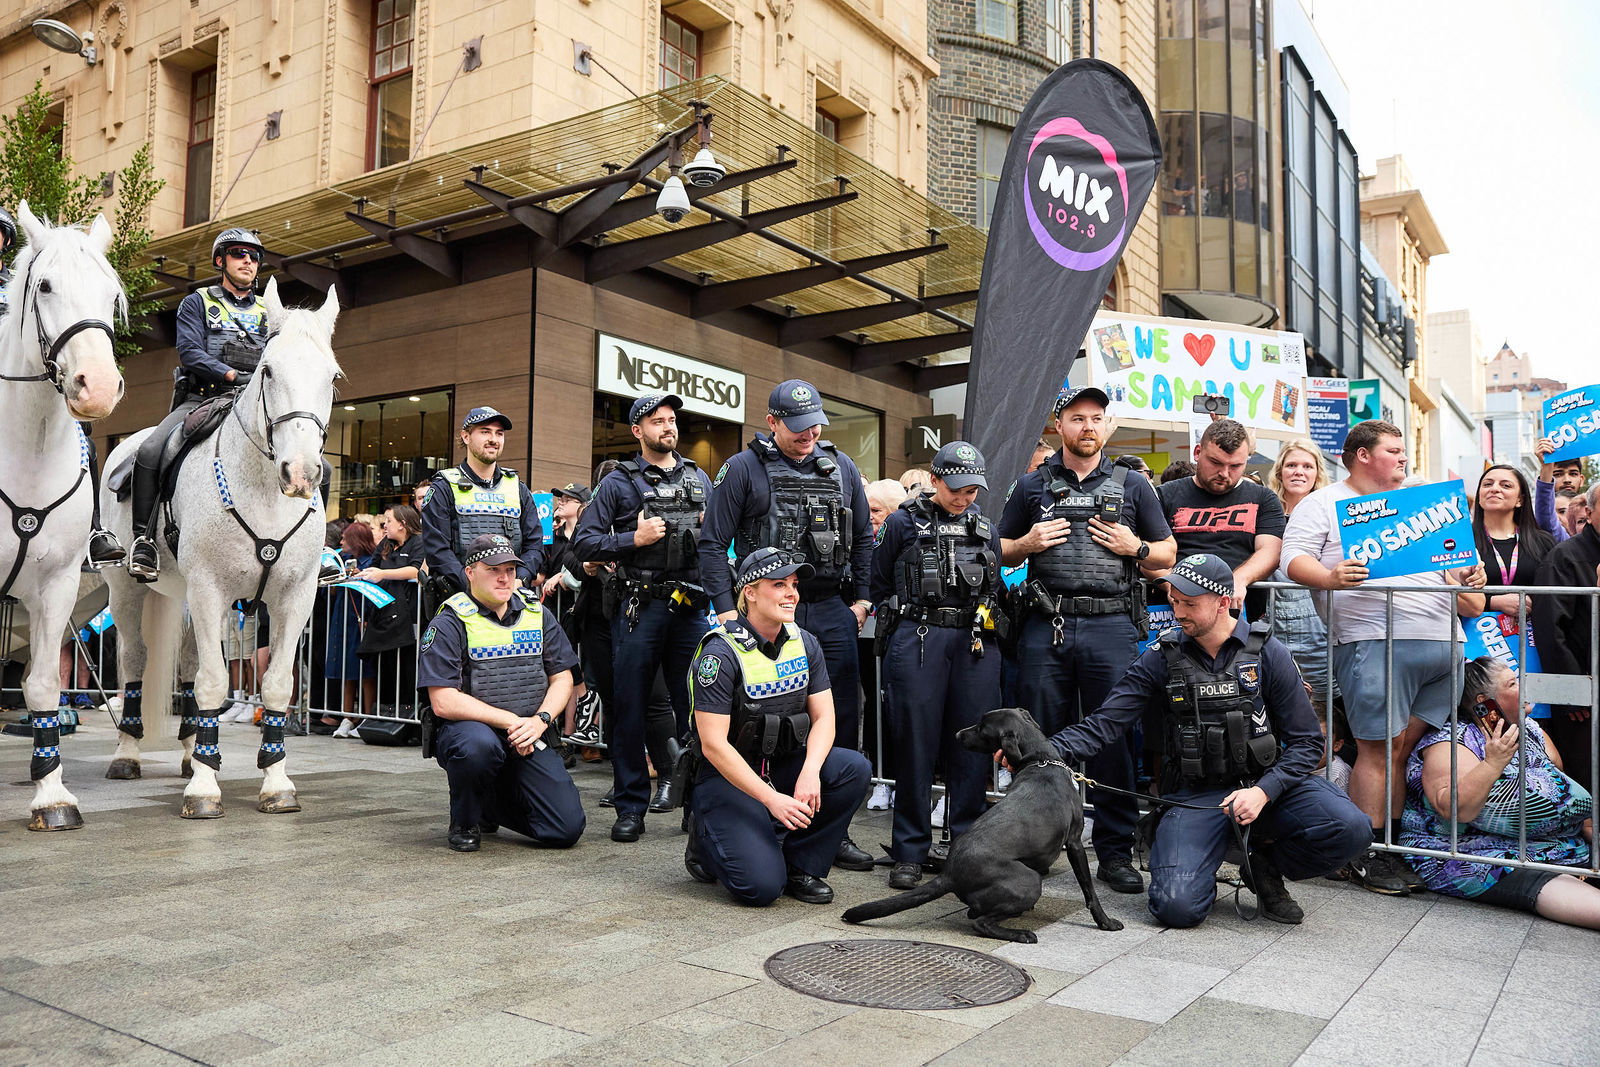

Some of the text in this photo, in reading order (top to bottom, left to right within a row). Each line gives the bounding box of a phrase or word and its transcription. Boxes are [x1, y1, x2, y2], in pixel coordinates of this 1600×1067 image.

[1038, 154, 1113, 224] MIX
[1047, 202, 1096, 239] 102.3
[1134, 325, 1251, 371] WE U
[613, 345, 741, 409] NESPRESSO
[1128, 371, 1265, 420] SAMMY
[1551, 391, 1586, 410] SAMMY
[1547, 424, 1579, 449] GO
[1059, 496, 1091, 507] POLICE
[1347, 499, 1387, 517] SAMMY
[1188, 509, 1248, 527] UFC
[1348, 496, 1464, 566] GO SAMMY
[1431, 554, 1452, 563] MAX
[1458, 550, 1473, 559] ALI
[514, 631, 541, 641] POLICE
[777, 658, 808, 674] POLICE
[1200, 687, 1235, 696] POLICE
